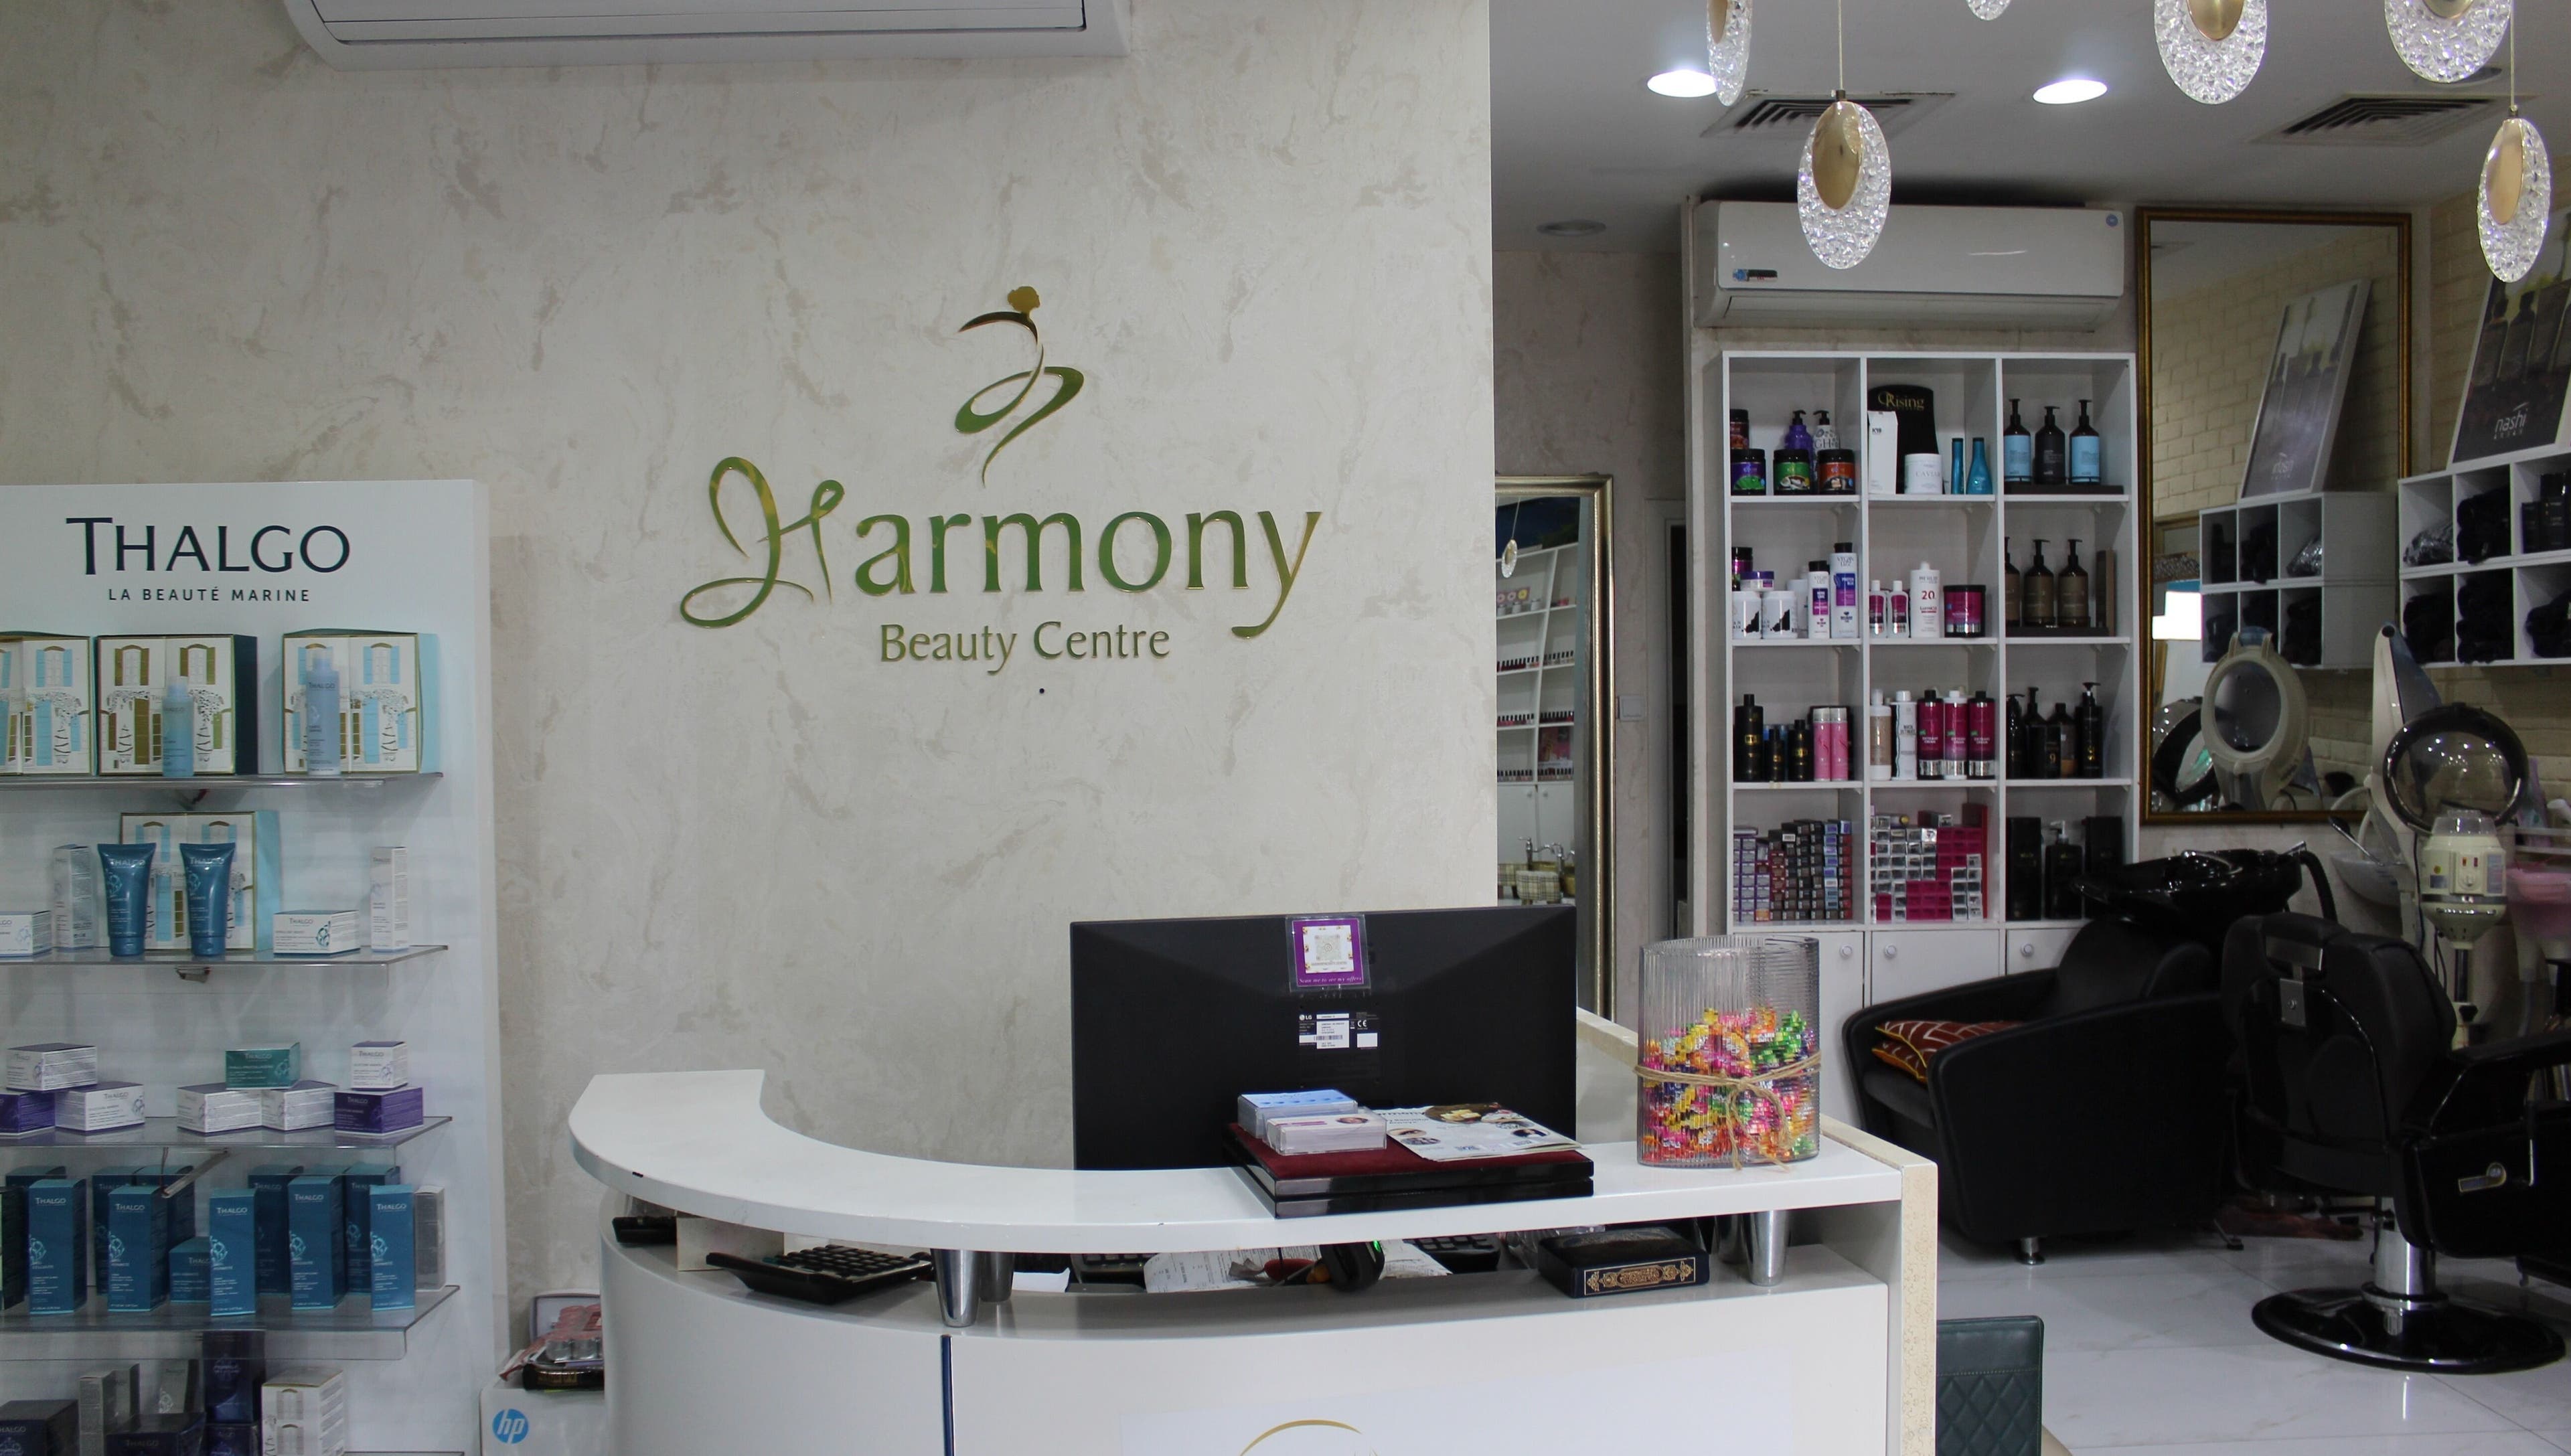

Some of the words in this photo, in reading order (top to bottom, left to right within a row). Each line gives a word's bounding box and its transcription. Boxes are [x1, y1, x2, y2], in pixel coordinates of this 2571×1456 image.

[2494, 408, 2527, 433] nashi
[66, 517, 351, 576] THALGO
[679, 456, 1322, 640] Harmony
[108, 588, 131, 601] LA
[142, 586, 220, 601] BEAUTÉ
[232, 589, 310, 601] MARINE
[1921, 590, 1935, 600] 20
[880, 623, 1017, 674] Beauty
[1033, 621, 1170, 661] Centre
[110, 858, 145, 867] THALGO
[189, 858, 224, 866] THALGO
[1357, 1020, 1367, 1028] CE
[115, 1203, 145, 1211] THALGO
[496, 1410, 527, 1444] hp
